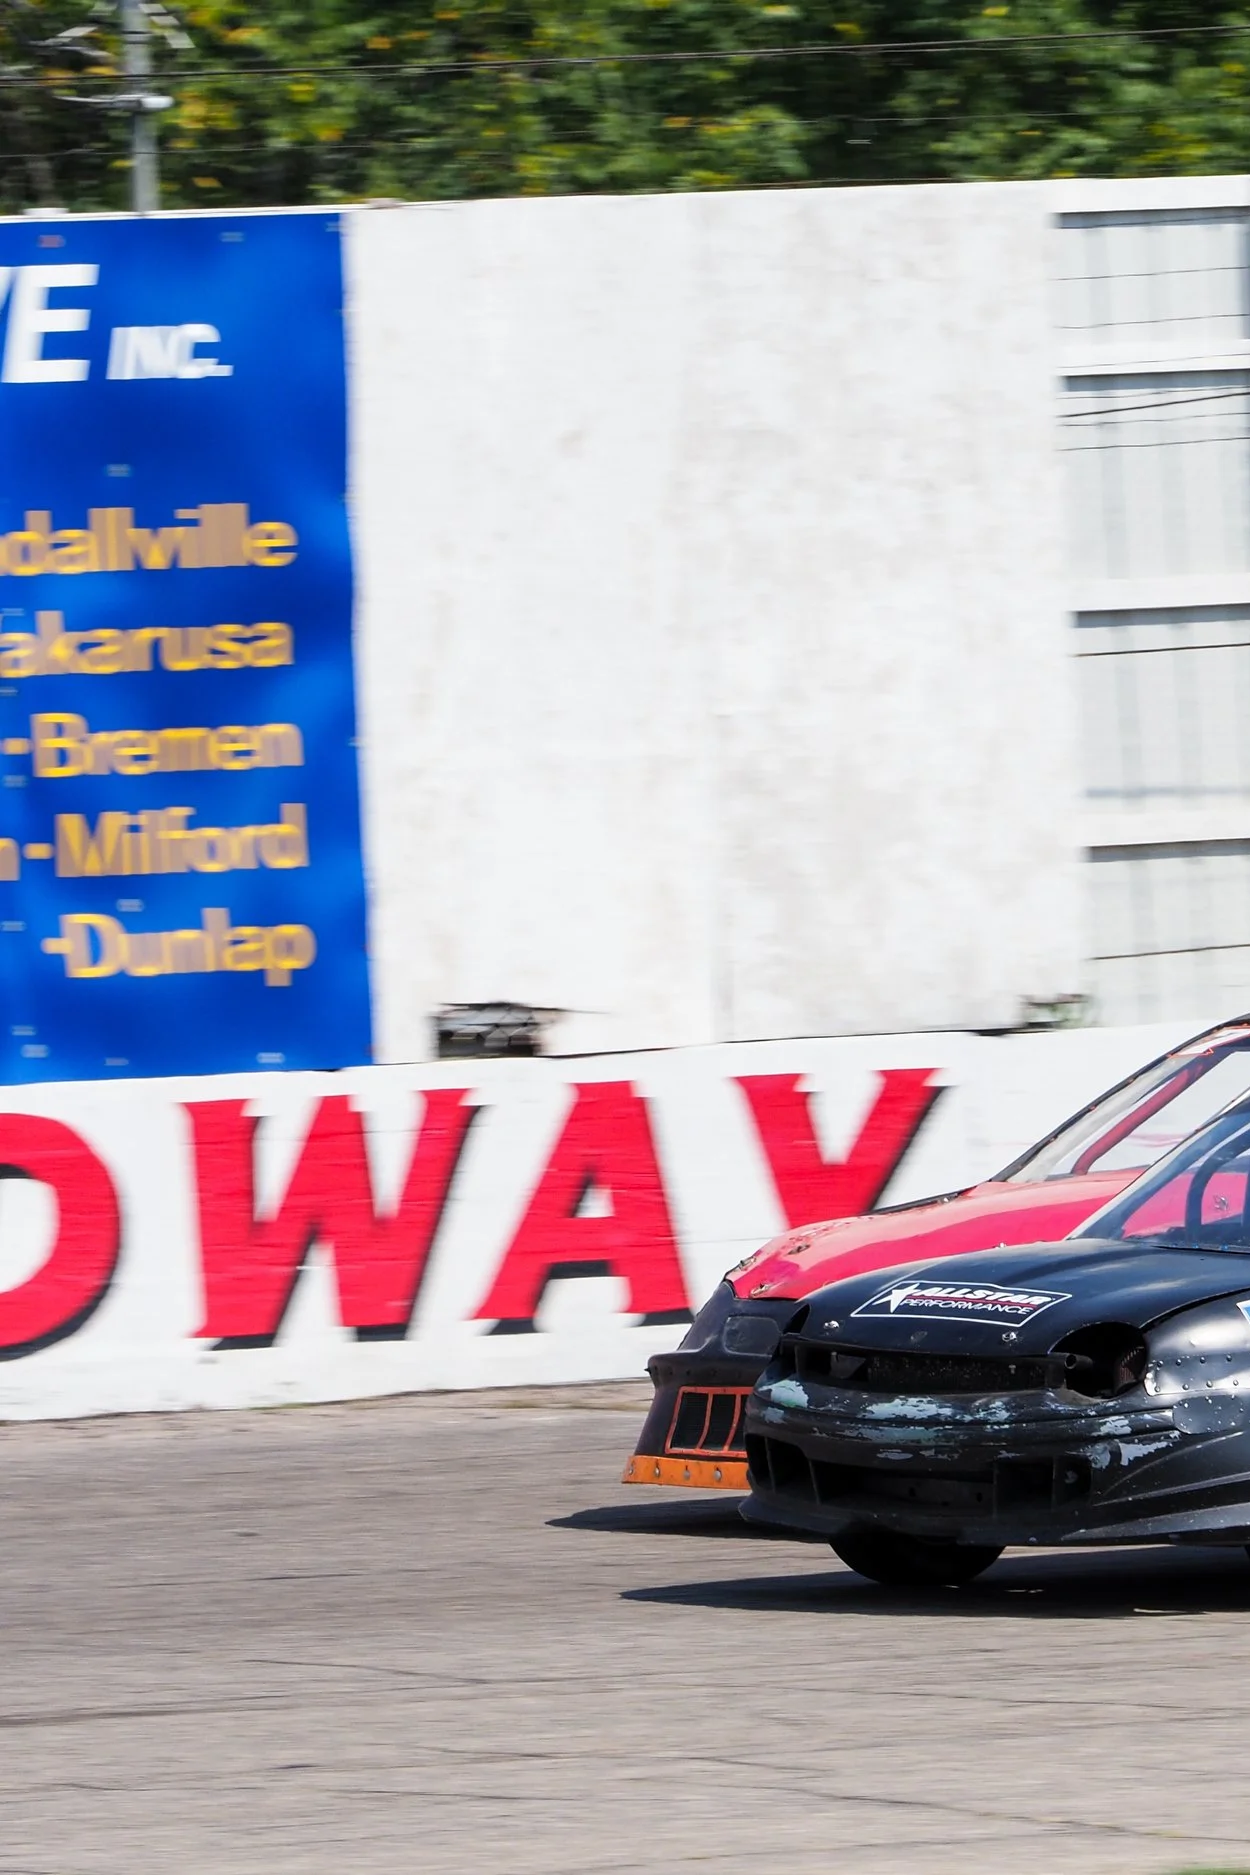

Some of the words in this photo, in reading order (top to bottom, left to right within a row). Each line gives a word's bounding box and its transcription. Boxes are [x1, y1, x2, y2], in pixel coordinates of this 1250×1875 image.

[0, 264, 99, 383] E
[106, 323, 233, 380] INC.
[0, 503, 299, 576] dallville
[0, 611, 293, 678] akarusa
[900, 1298, 1034, 1315] PERFORMANCE
[907, 1287, 1053, 1305] ALLSTAR
